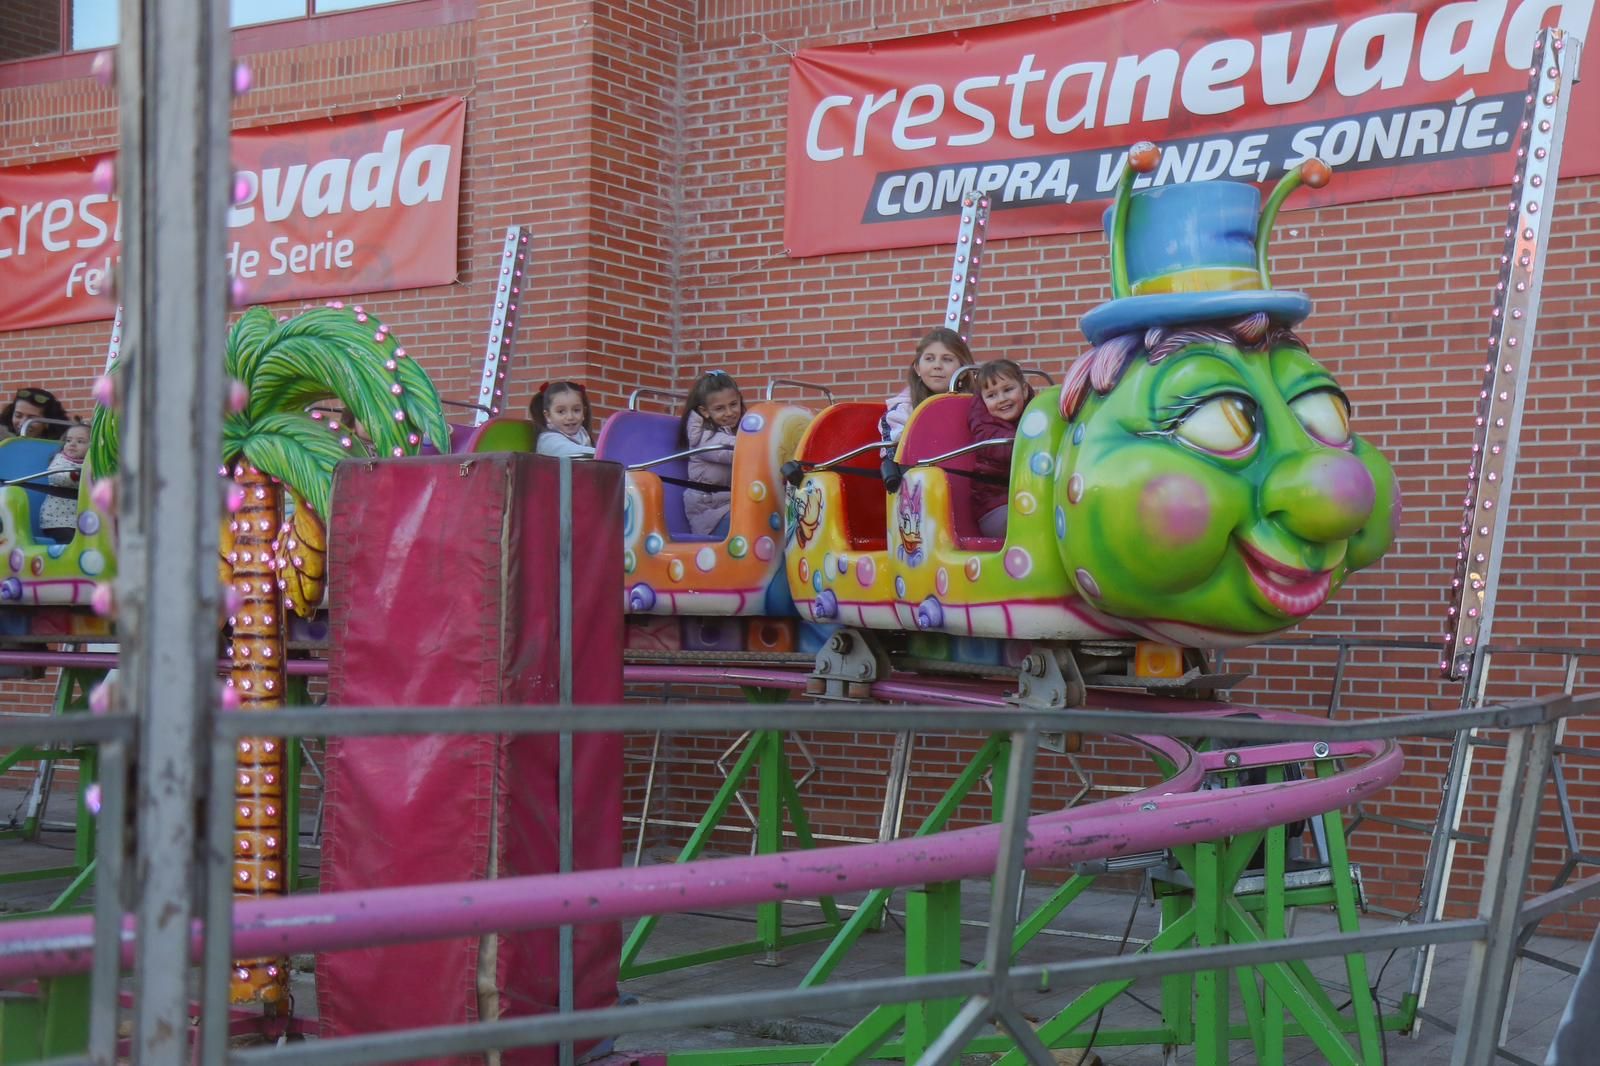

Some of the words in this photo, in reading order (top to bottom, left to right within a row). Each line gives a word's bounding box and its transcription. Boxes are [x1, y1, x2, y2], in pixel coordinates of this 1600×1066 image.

[805, 0, 1596, 162] crestanevada
[876, 158, 1080, 216] COMPRA,
[1283, 88, 1509, 171] SONRÍE.
[268, 230, 354, 276] Serie
